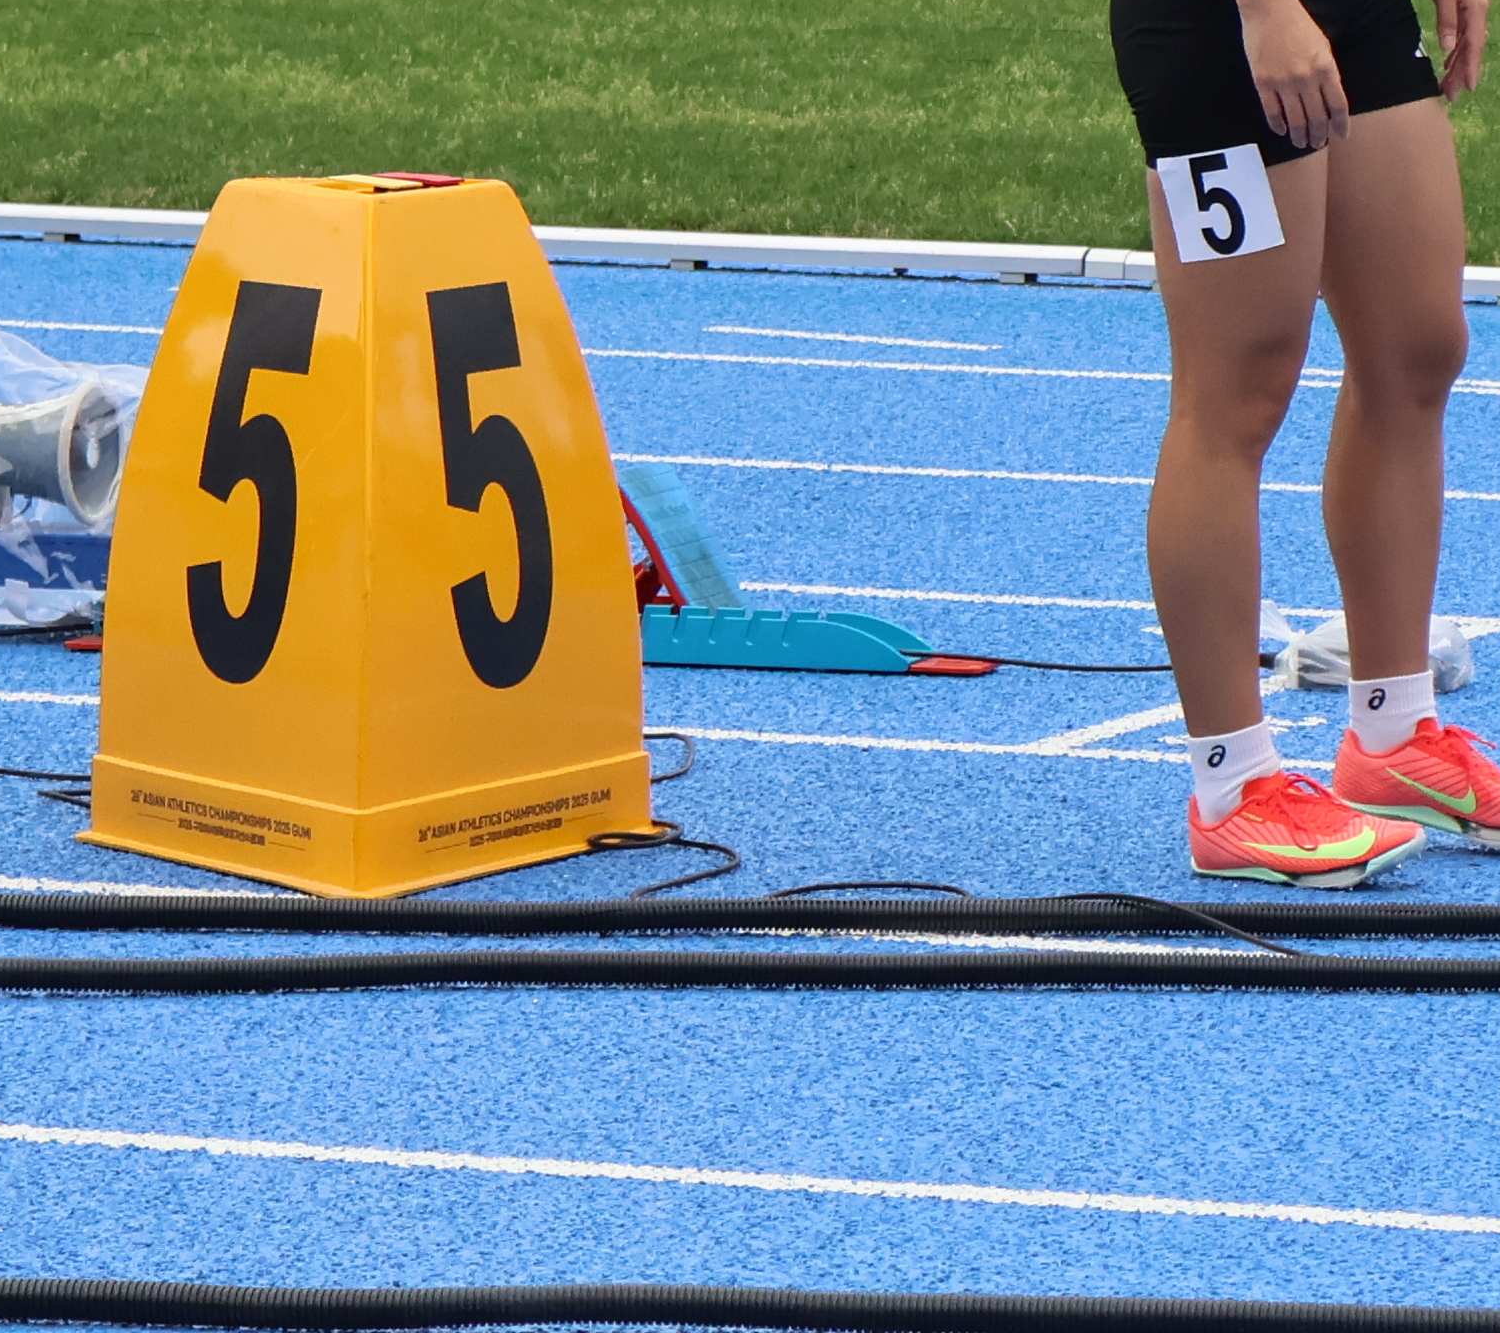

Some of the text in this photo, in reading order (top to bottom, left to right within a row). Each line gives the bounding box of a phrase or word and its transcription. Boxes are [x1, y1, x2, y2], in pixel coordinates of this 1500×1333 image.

[1188, 152, 1247, 255] 5
[186, 280, 323, 685] 5
[426, 281, 554, 690] 5
[143, 792, 166, 808] ASIAN
[166, 796, 207, 817] ATHLETICS
[209, 805, 273, 831] CHAMPIONSHIPS
[273, 819, 291, 836] 2025
[292, 823, 312, 840] GUMI
[432, 822, 456, 838] ASIAN
[458, 812, 502, 833] ATHLETICS
[503, 797, 570, 823] CHAMPIONSHIPS
[571, 793, 589, 809] 2025
[591, 788, 611, 804] GUMI
